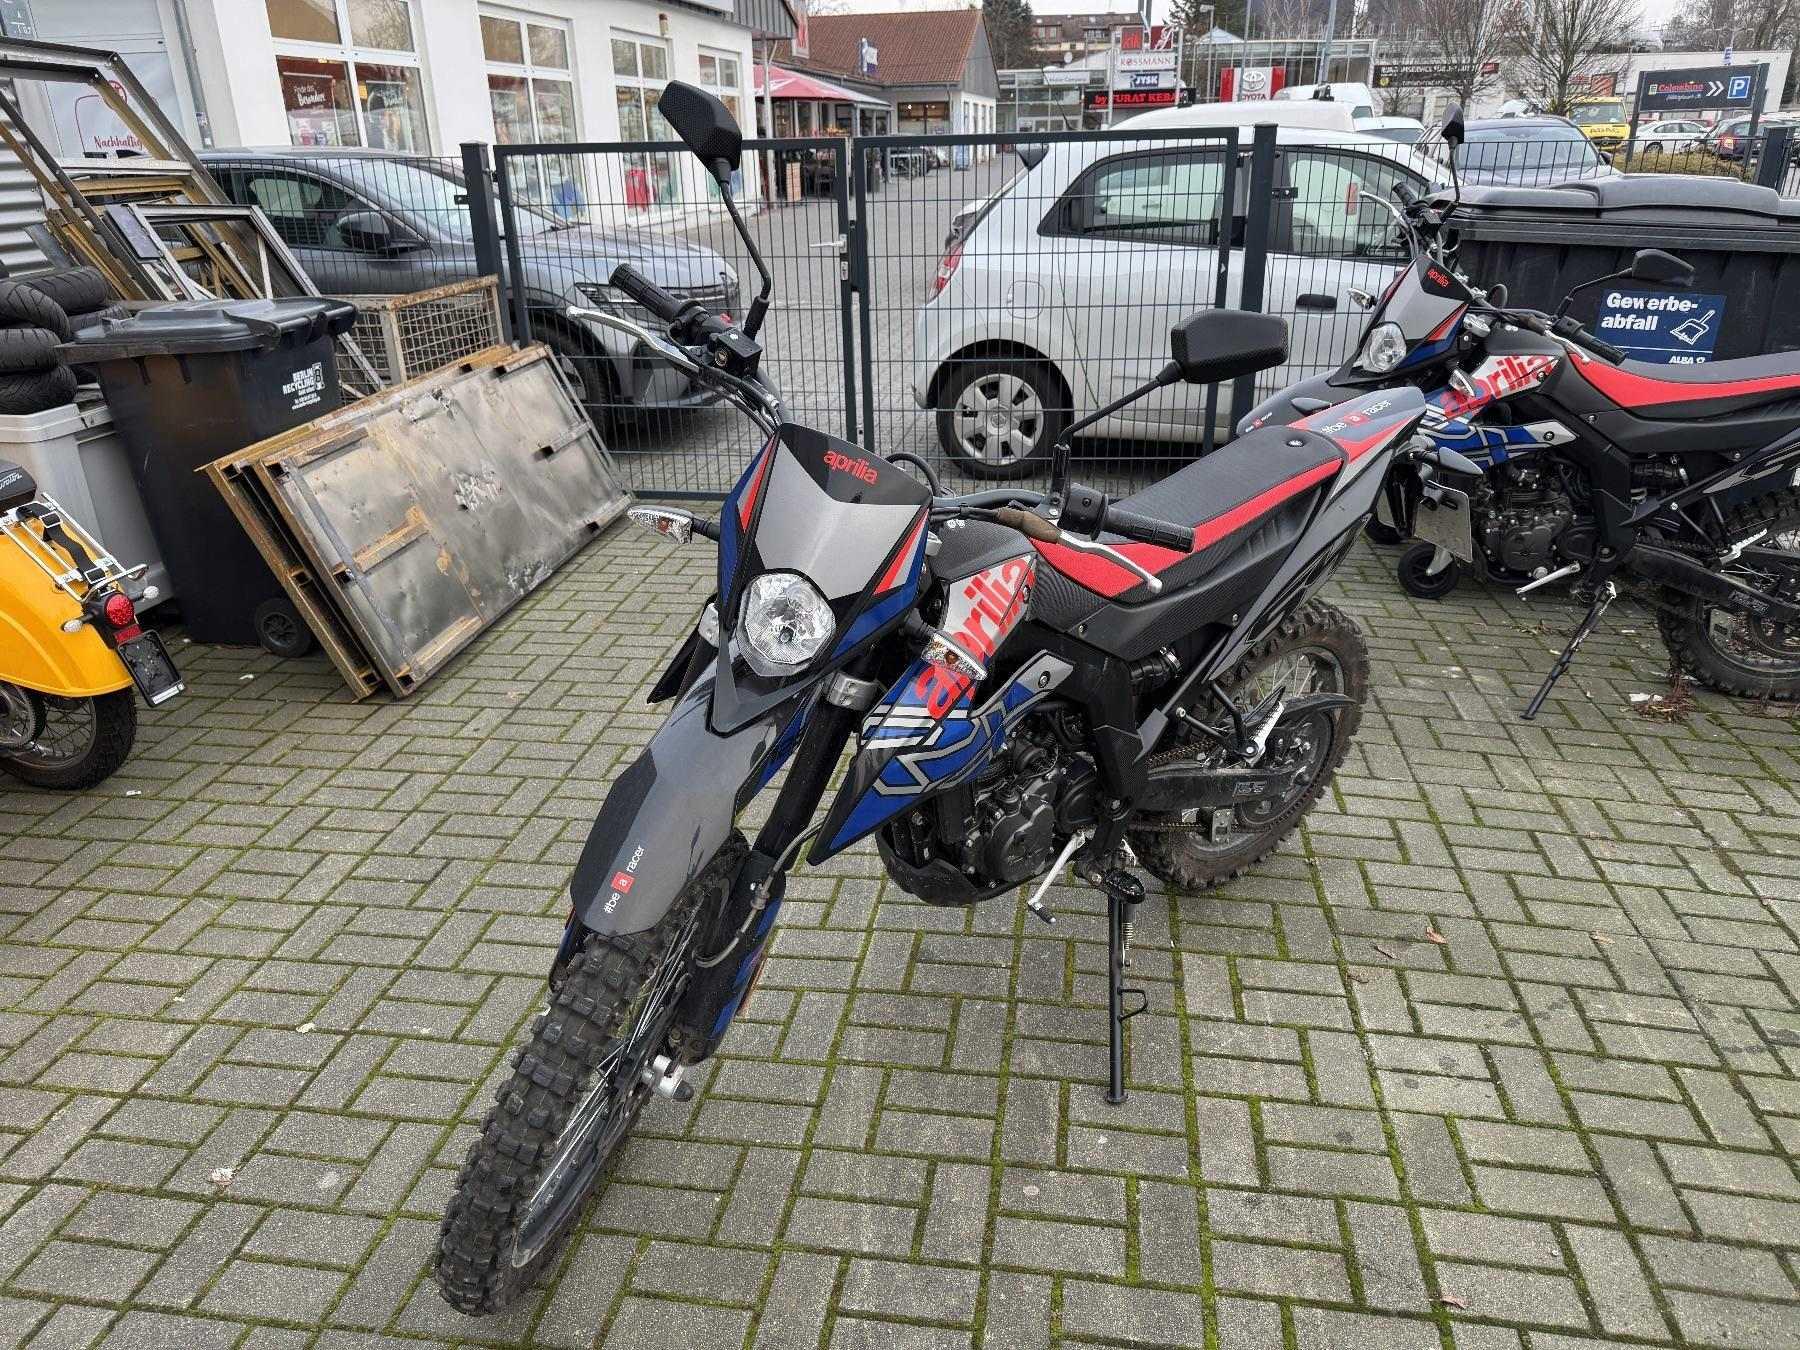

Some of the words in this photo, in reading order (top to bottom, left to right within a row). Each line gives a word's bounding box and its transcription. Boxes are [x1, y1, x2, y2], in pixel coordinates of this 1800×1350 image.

[1135, 75, 1158, 86] JYSK
[1732, 79, 1745, 96] P
[1427, 267, 1449, 288] aprilia
[1606, 292, 1698, 312] Gewerbe-
[1600, 313, 1659, 331] abfall
[1668, 355, 1694, 365] ALBA
[292, 367, 314, 382] BERLIN
[282, 376, 315, 395] RECYCLING
[1361, 399, 1392, 416] racer
[823, 449, 879, 486] aprilia
[603, 892, 621, 914] #be
[626, 844, 645, 873] racer
